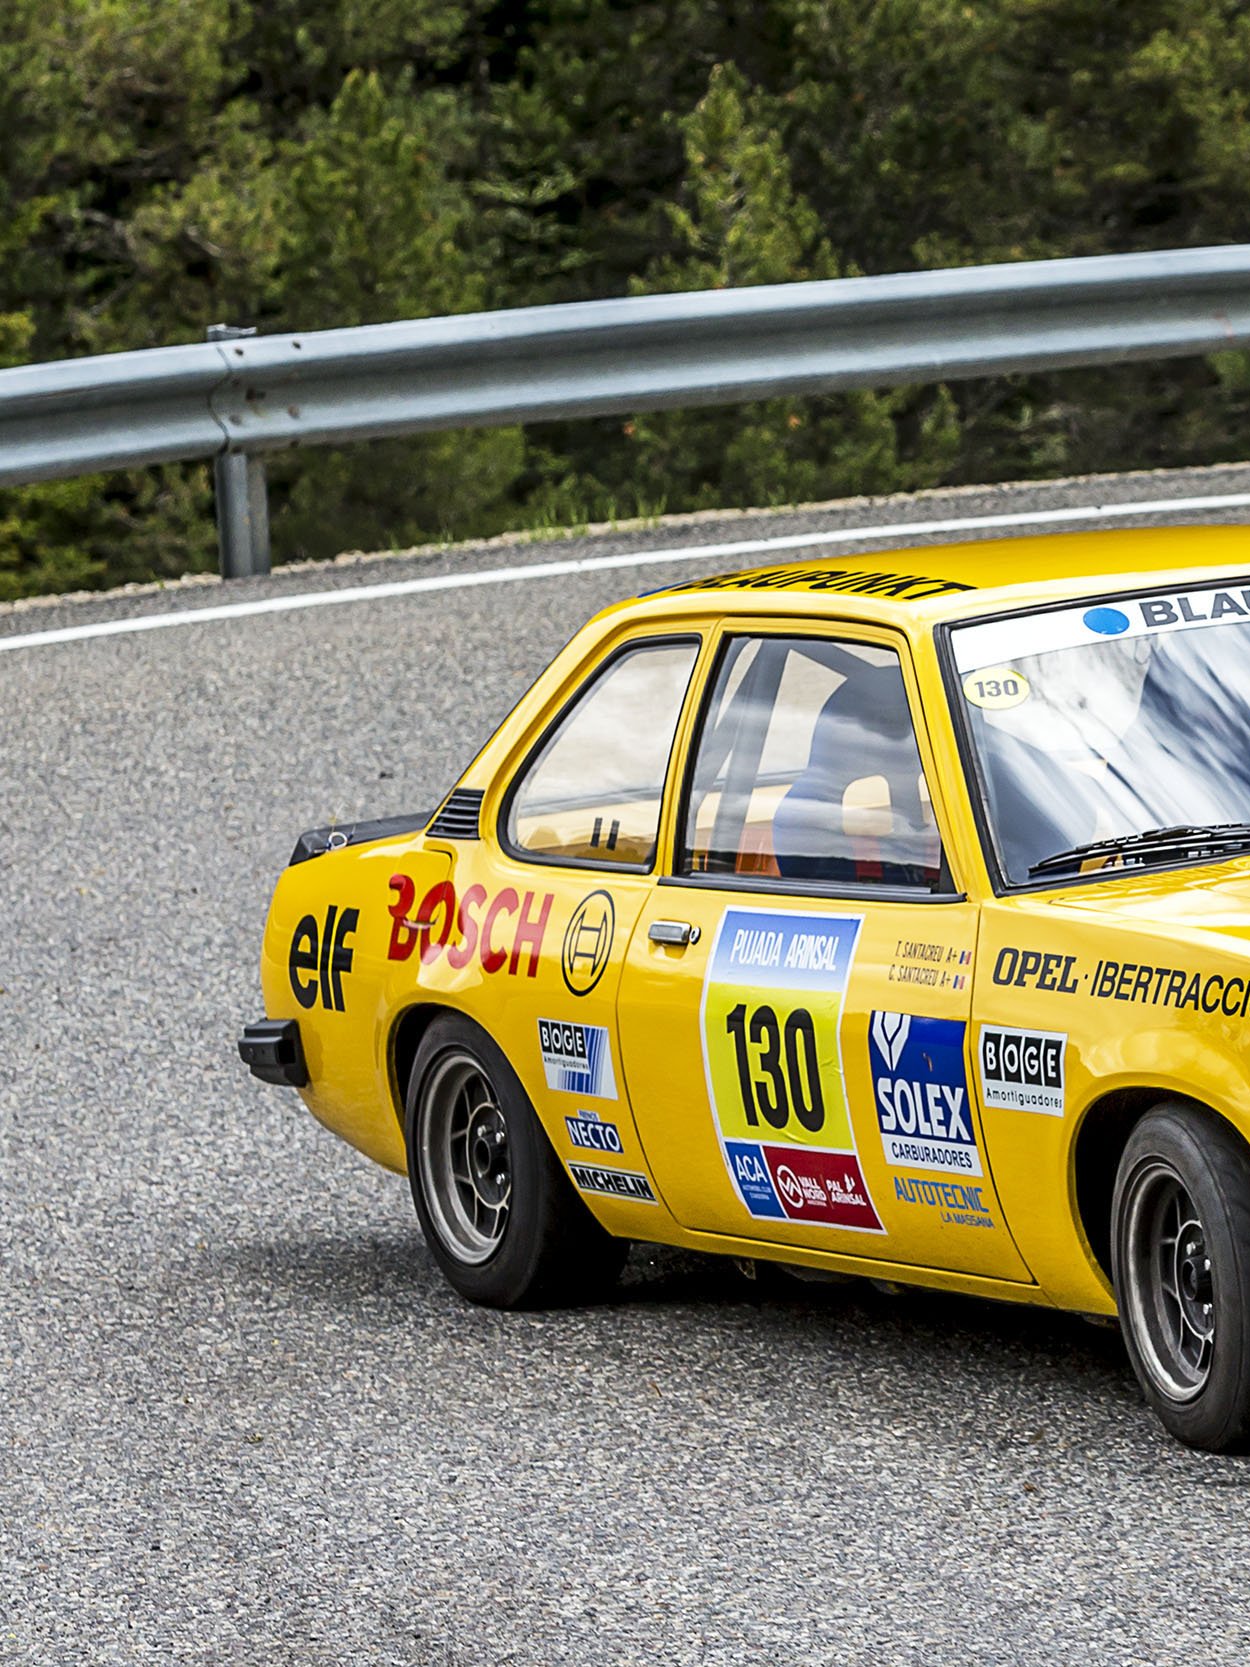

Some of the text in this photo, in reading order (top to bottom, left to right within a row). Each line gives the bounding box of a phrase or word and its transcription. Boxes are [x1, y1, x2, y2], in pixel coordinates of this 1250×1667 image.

[973, 679, 1019, 699] 130
[387, 873, 554, 978] BOSCH
[288, 904, 361, 1012] elf
[730, 929, 839, 971] PUJADA ARINSAL
[992, 947, 1079, 994] OPEL
[541, 1026, 584, 1052] BOGE
[726, 1003, 825, 1133] 130
[985, 1041, 1057, 1078] BOGE
[877, 1077, 971, 1142] SOLEX
[986, 1087, 1063, 1109] Amortiguadores
[566, 1120, 621, 1152] NECTO
[734, 1154, 768, 1183] ACA
[891, 1141, 972, 1169] CARBURADORES
[571, 1167, 655, 1199] MICHELIN
[798, 1175, 820, 1190] VALL
[802, 1188, 827, 1201] NORD
[826, 1179, 844, 1193] PAL
[893, 1176, 990, 1213] AUTOTECNIC
[940, 1211, 953, 1223] LA
